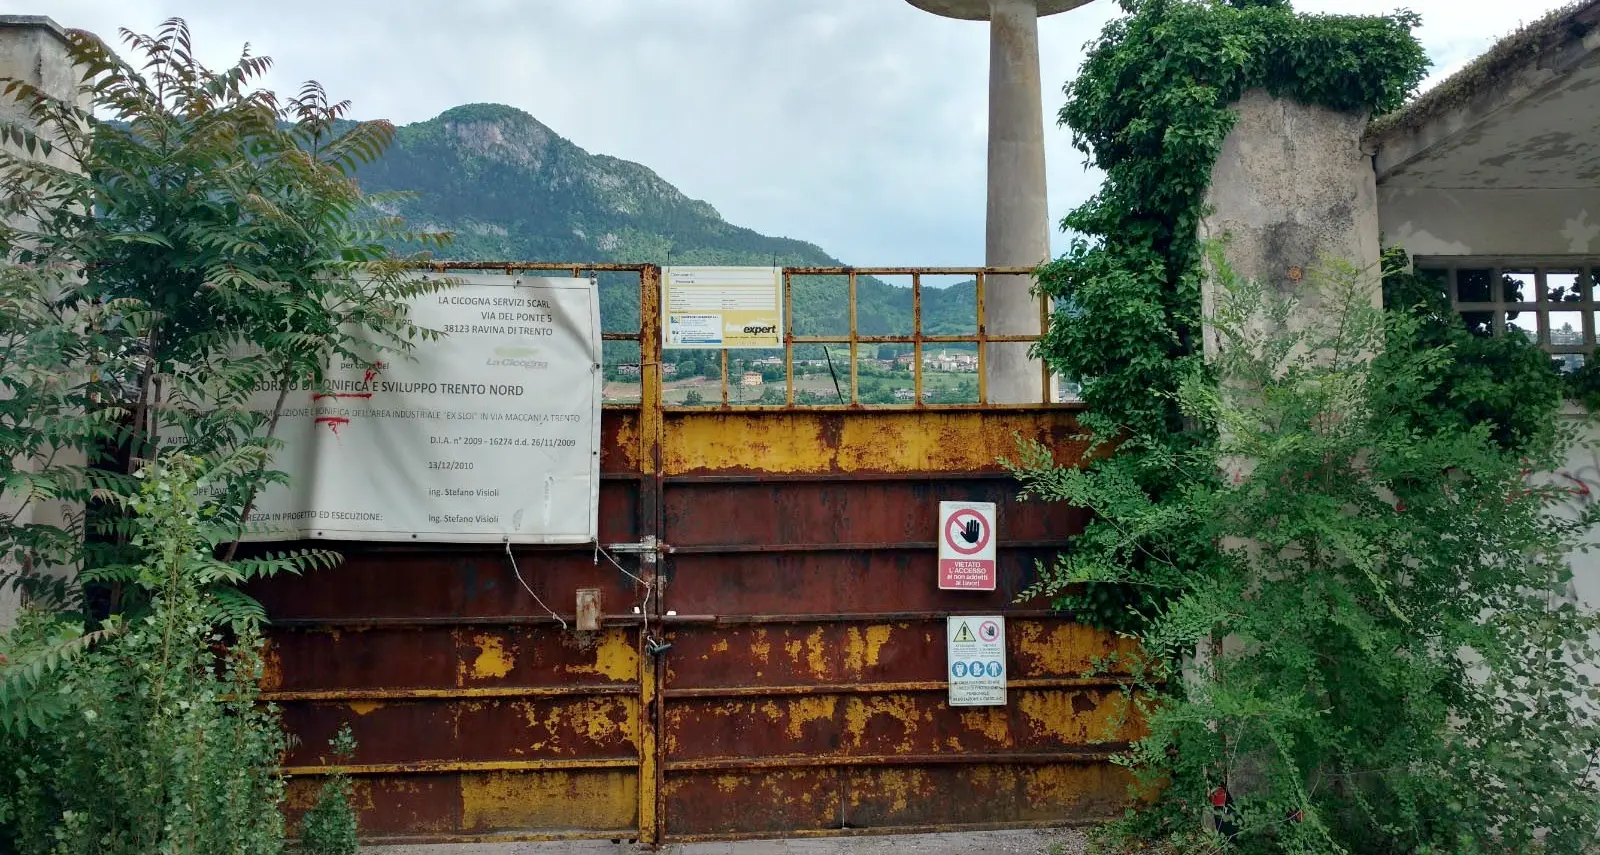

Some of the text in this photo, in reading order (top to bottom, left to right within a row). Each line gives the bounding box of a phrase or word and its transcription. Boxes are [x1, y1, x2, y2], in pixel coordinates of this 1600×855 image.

[438, 296, 551, 308] LA CICOGNA SERVIZI SCARL
[481, 311, 553, 323] VIA DEL PONTE 5
[443, 324, 553, 336] 38123 RAVINA DI TRENTO
[743, 325, 776, 335] expert
[340, 362, 353, 371] per
[486, 357, 549, 370] La Cicogna
[322, 378, 369, 392] ONIFICA
[372, 381, 379, 392] E
[381, 381, 437, 394] SVILUPPO
[440, 383, 486, 395] TRENTO
[489, 384, 524, 396] NORD
[351, 409, 391, 418] DELL'AREA
[392, 409, 441, 419] INDUSTRIALE
[480, 412, 489, 421] IN
[490, 413, 503, 421] VIA
[505, 413, 541, 422] MACCANI
[543, 414, 549, 422] A
[551, 414, 580, 422] TRENTO
[430, 436, 452, 445] D.I.A.
[463, 437, 483, 446] 2009
[489, 438, 512, 446] 16274
[514, 438, 529, 446] d.d.
[531, 438, 576, 448] 26/11/2009
[428, 461, 474, 471] 13/12/2010
[428, 488, 500, 498] ing. Stefano Visioli
[272, 512, 281, 521] IN
[282, 510, 317, 521] PROGETTO
[319, 510, 330, 519] ED
[331, 511, 384, 521] ESECUZIONE:
[428, 514, 499, 524] ing. Stefano Visioli
